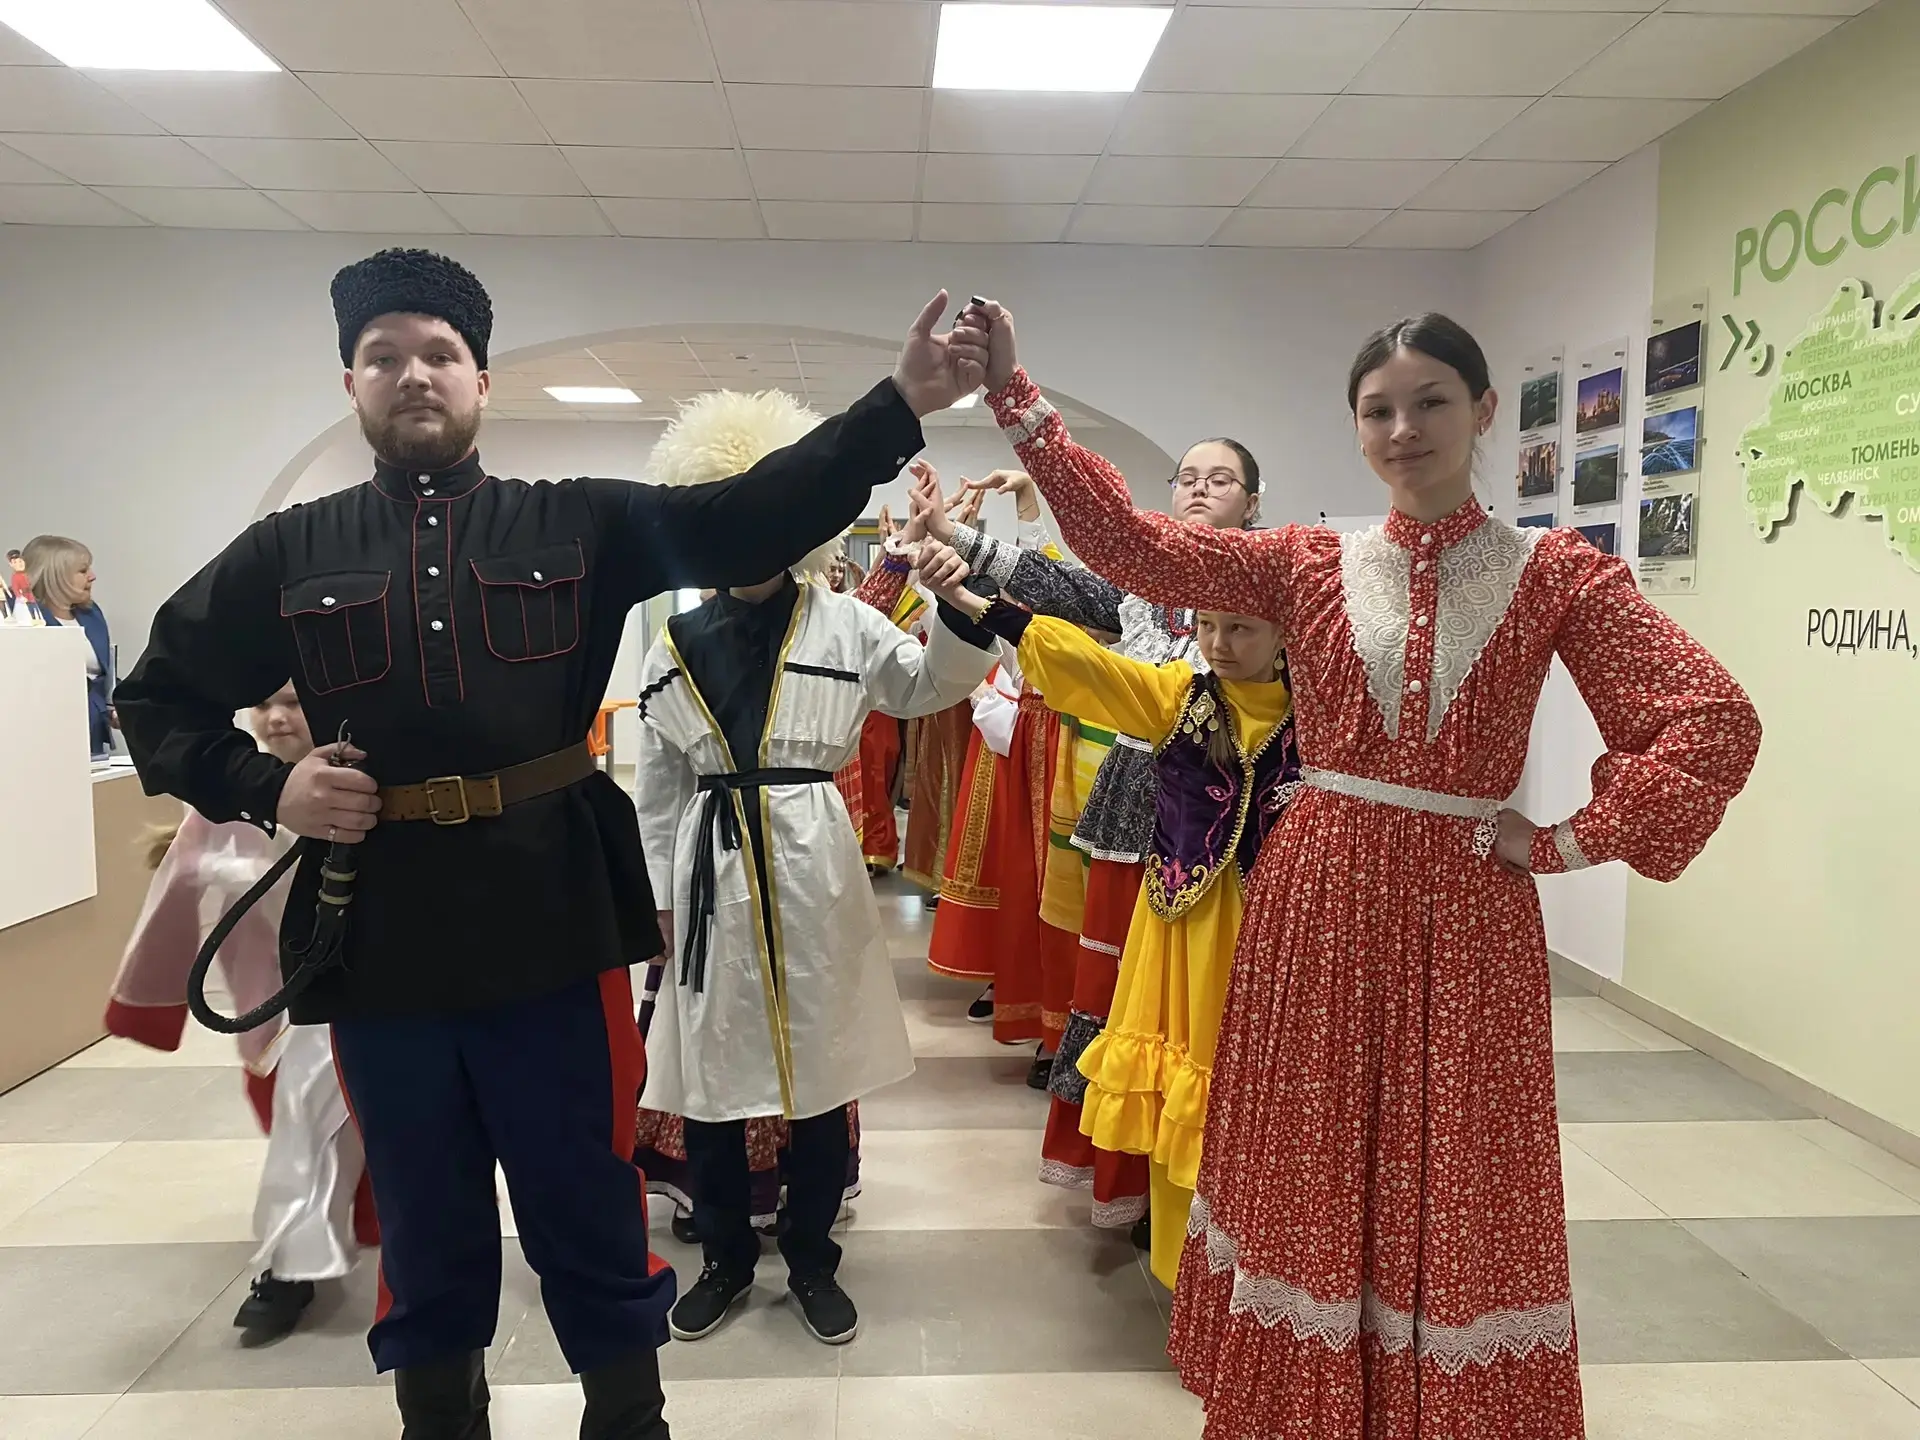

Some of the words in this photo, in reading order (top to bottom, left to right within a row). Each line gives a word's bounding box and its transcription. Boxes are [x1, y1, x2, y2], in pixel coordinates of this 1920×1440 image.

[1784, 369, 1852, 403] МОСКВА
[1852, 437, 1919, 465] ТЮМЕНЬ
[1817, 466, 1880, 486] ЧЕЛЯБИНСК
[1747, 485, 1779, 503] СОЧИ
[1807, 607, 1918, 658] РОДИНА,
